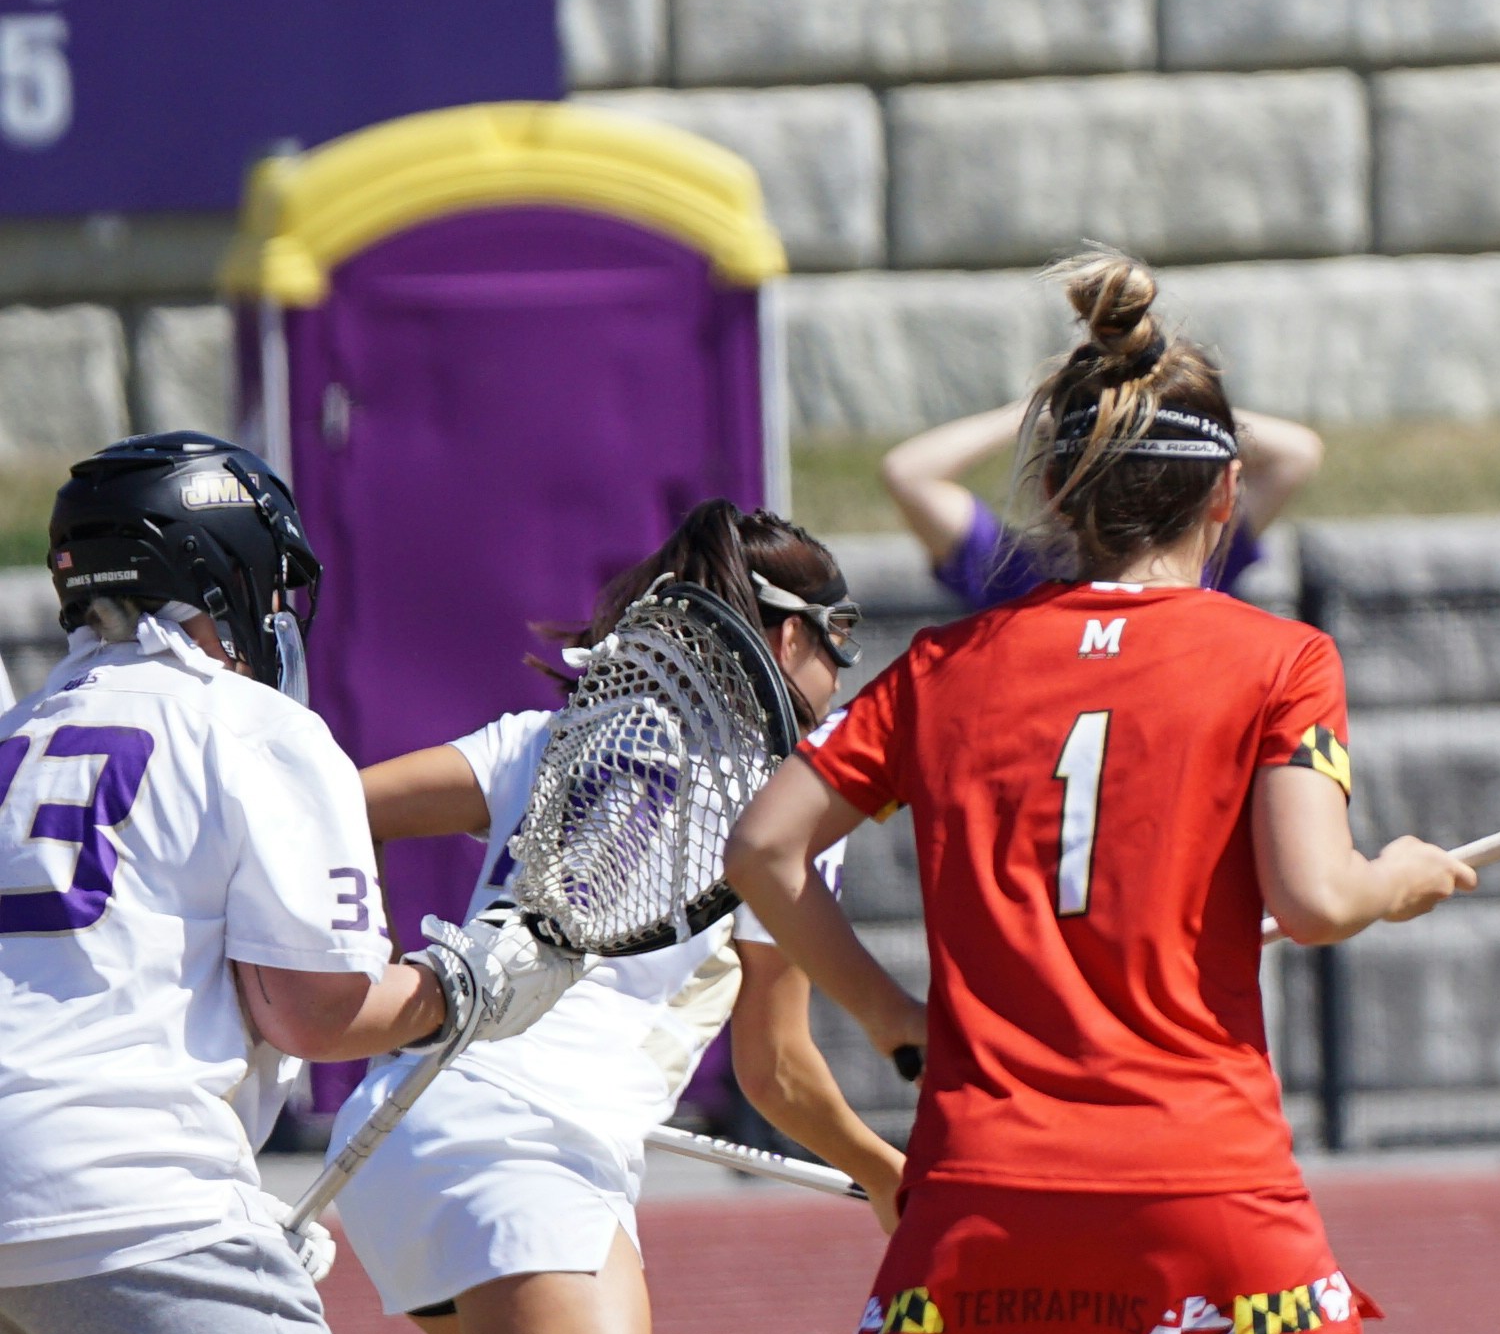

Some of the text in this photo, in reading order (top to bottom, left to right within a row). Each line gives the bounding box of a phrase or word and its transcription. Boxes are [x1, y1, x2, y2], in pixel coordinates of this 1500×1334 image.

[93, 570, 138, 583] MADISON
[1078, 617, 1128, 655] M
[1053, 709, 1112, 917] 1
